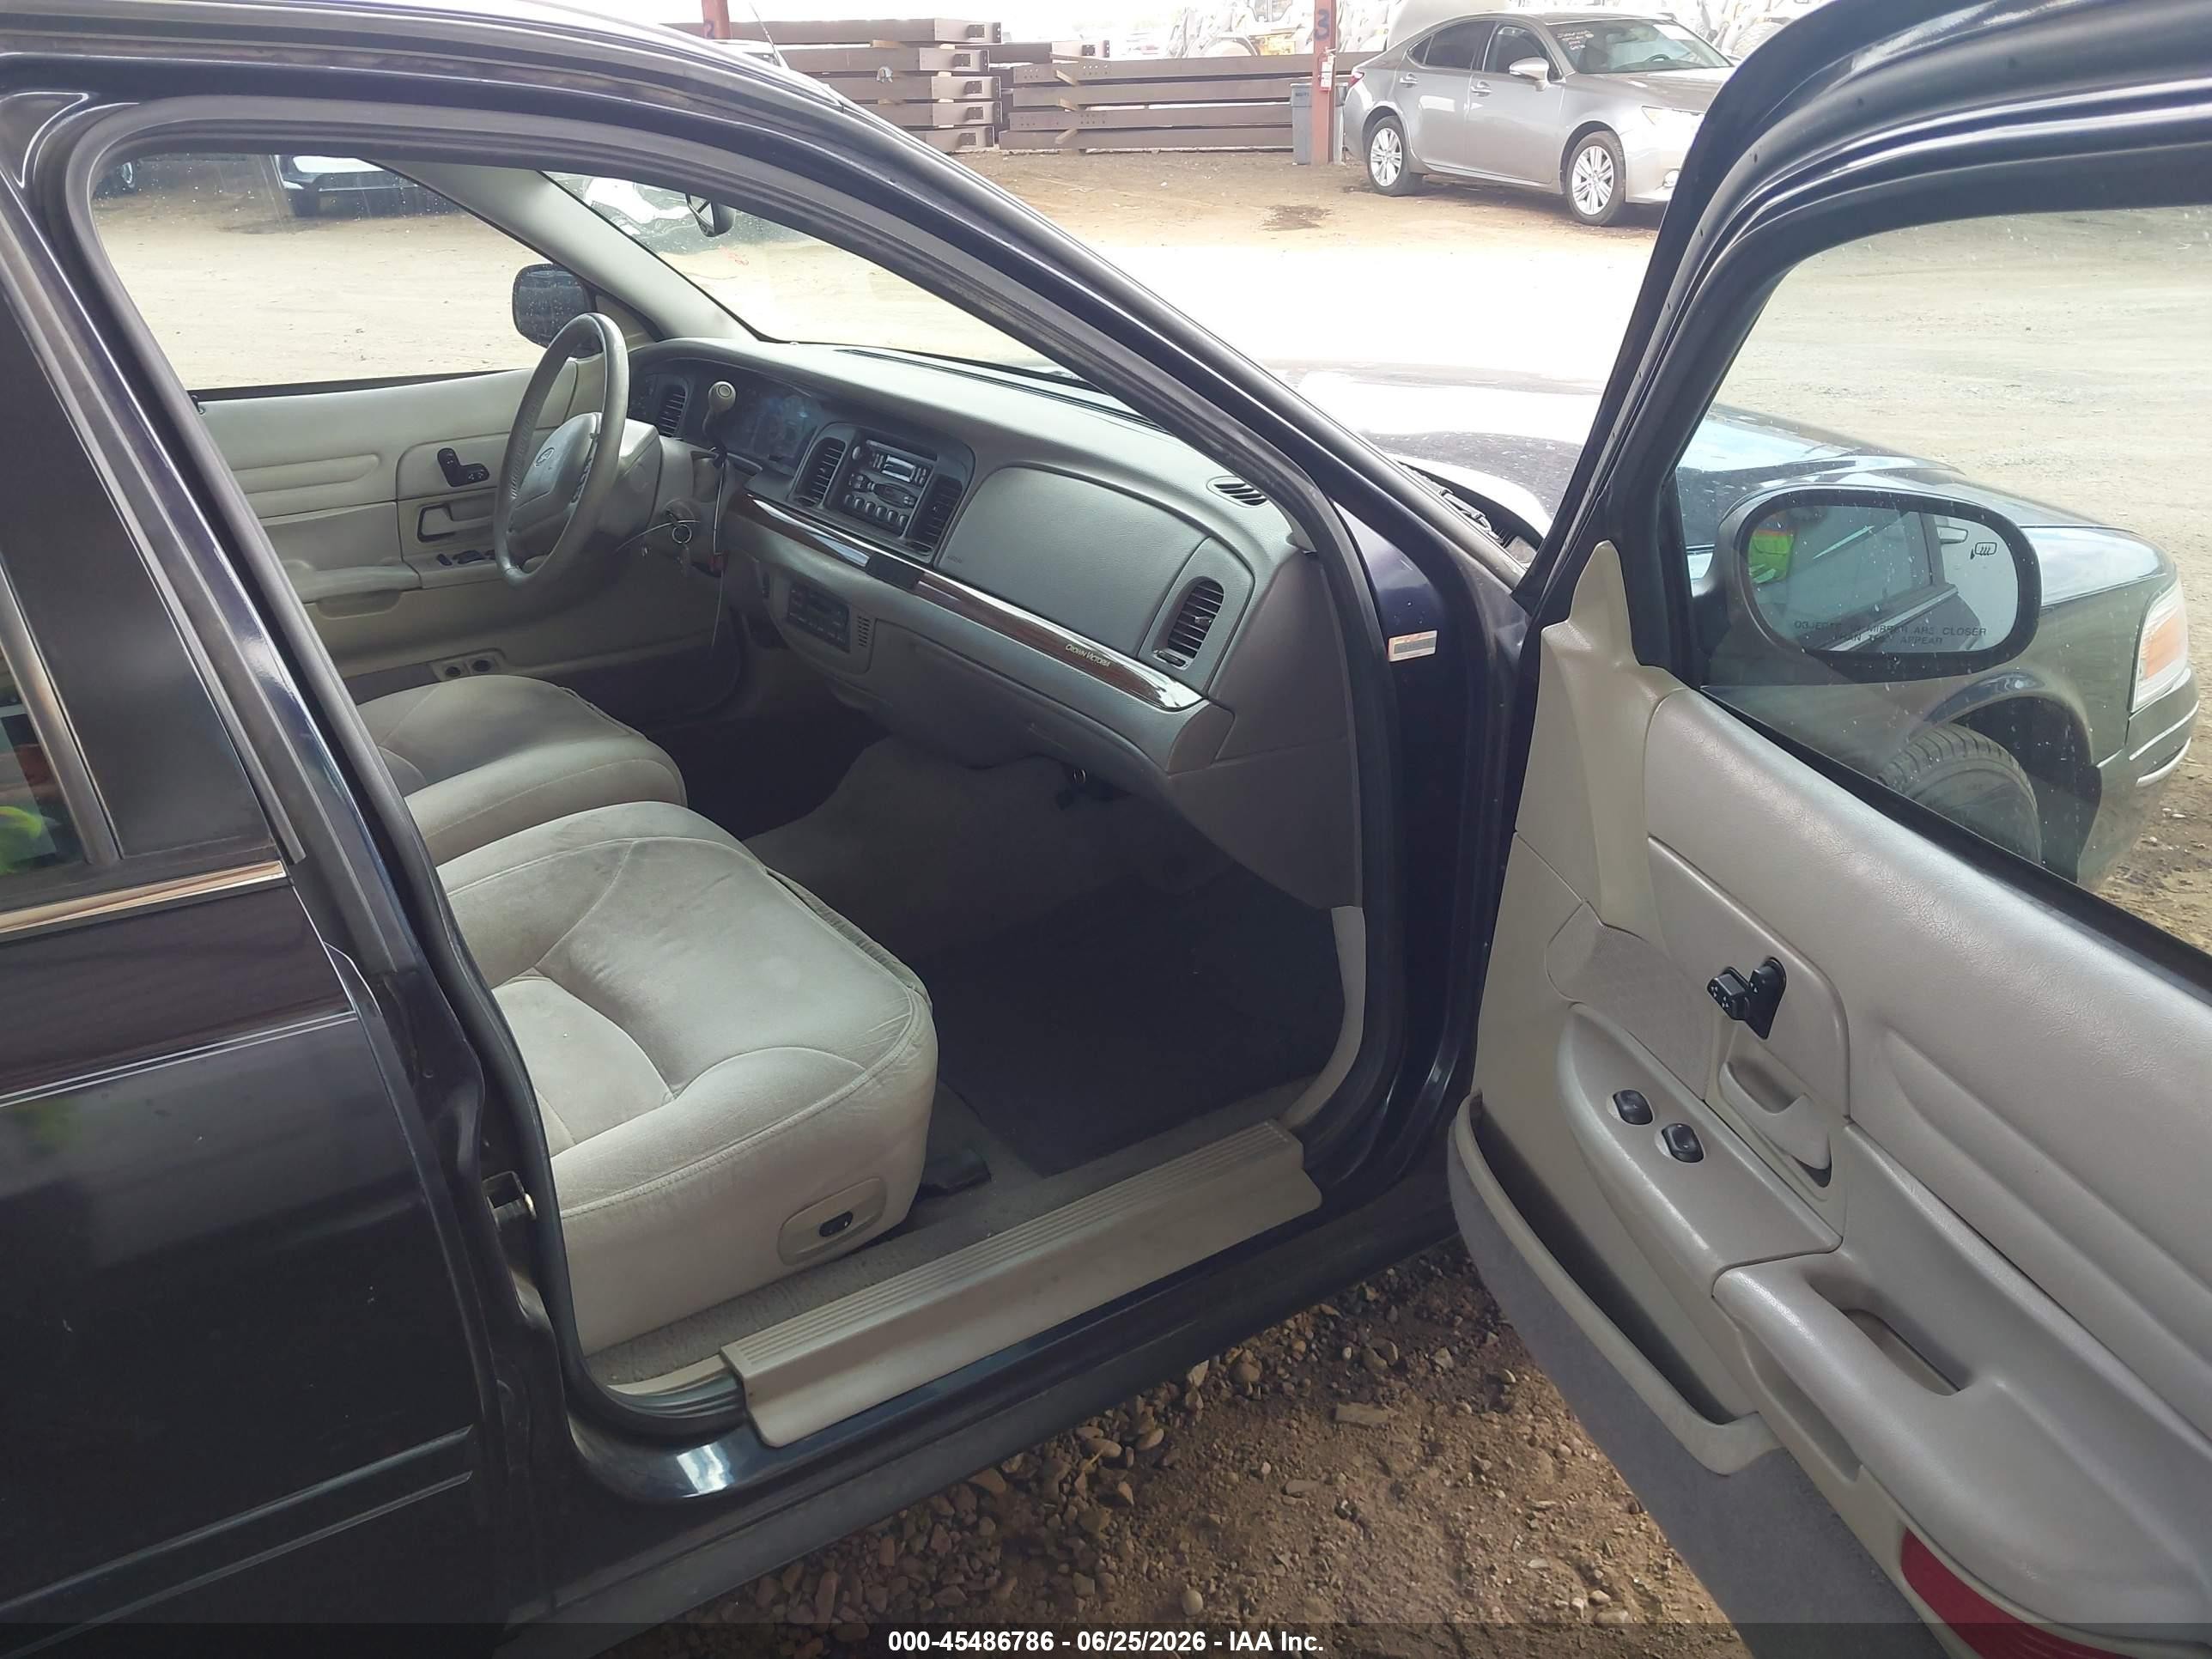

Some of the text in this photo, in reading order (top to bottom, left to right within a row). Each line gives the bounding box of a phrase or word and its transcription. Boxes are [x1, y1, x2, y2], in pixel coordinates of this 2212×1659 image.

[1314, 9, 1329, 40] 3
[1913, 626, 1935, 635] ARE
[1942, 627, 1986, 636] CLOSER
[1899, 635, 1943, 645] APPEAR
[1065, 644, 1111, 667] CROWN VICTORIA
